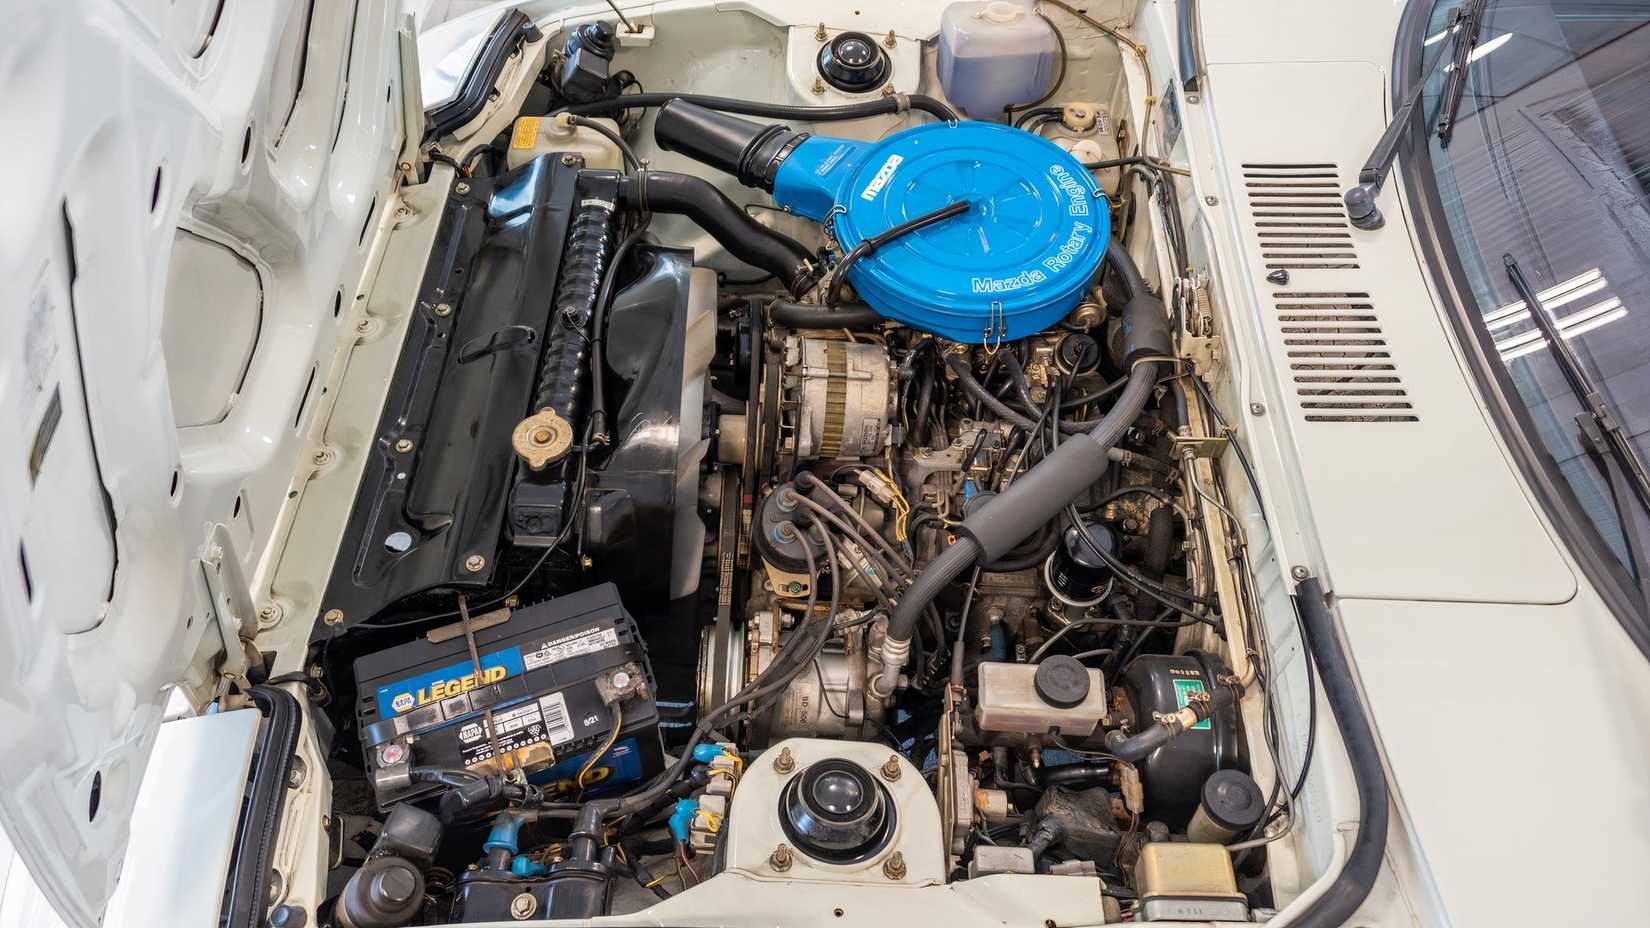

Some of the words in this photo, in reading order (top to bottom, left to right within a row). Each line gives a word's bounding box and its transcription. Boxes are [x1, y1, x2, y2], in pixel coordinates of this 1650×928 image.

[861, 154, 904, 201] mazda
[1049, 164, 1089, 216] Engine
[1042, 221, 1093, 272] Rotary
[971, 269, 1047, 293] Mazda
[416, 666, 507, 705] LEGEND
